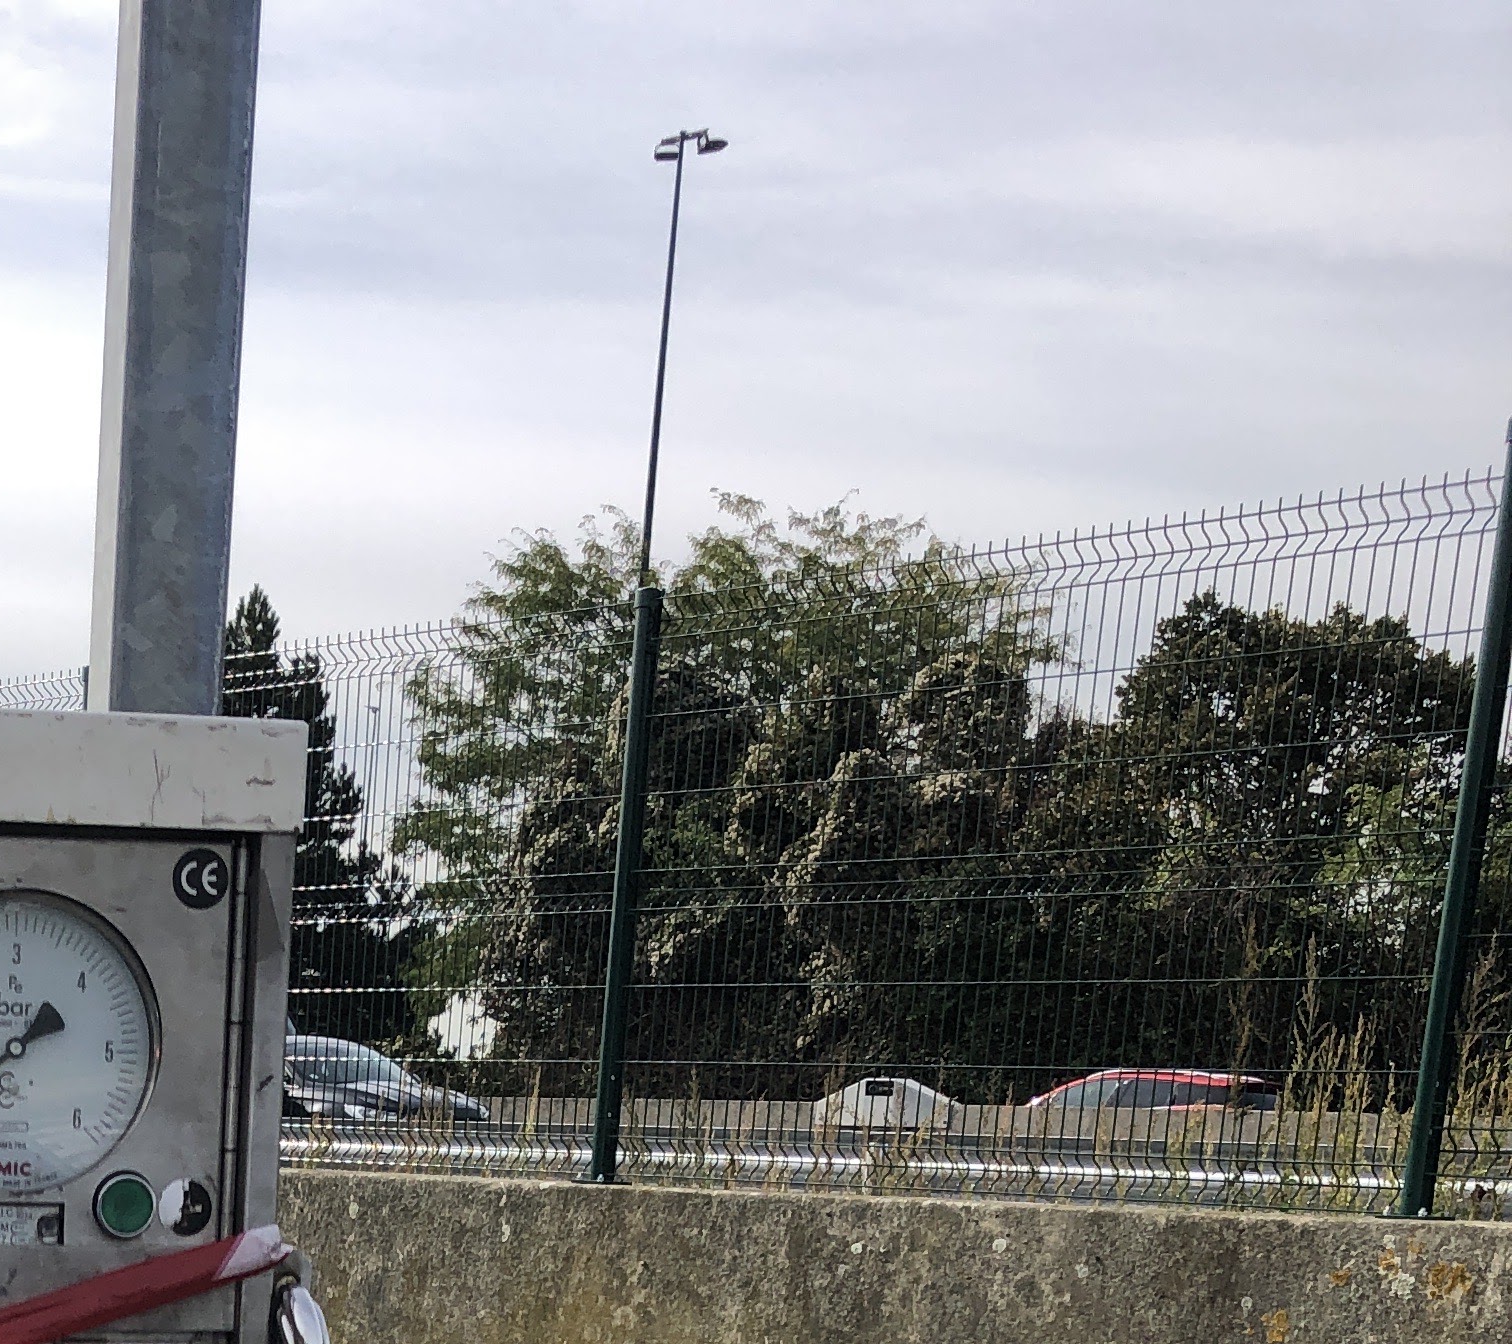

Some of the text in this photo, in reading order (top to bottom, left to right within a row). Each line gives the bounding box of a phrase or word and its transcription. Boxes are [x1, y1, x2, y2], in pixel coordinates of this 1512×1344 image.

[12, 943, 21, 965] 3
[77, 971, 86, 993] 4
[105, 1041, 114, 1062] 5
[72, 1108, 82, 1129] 6
